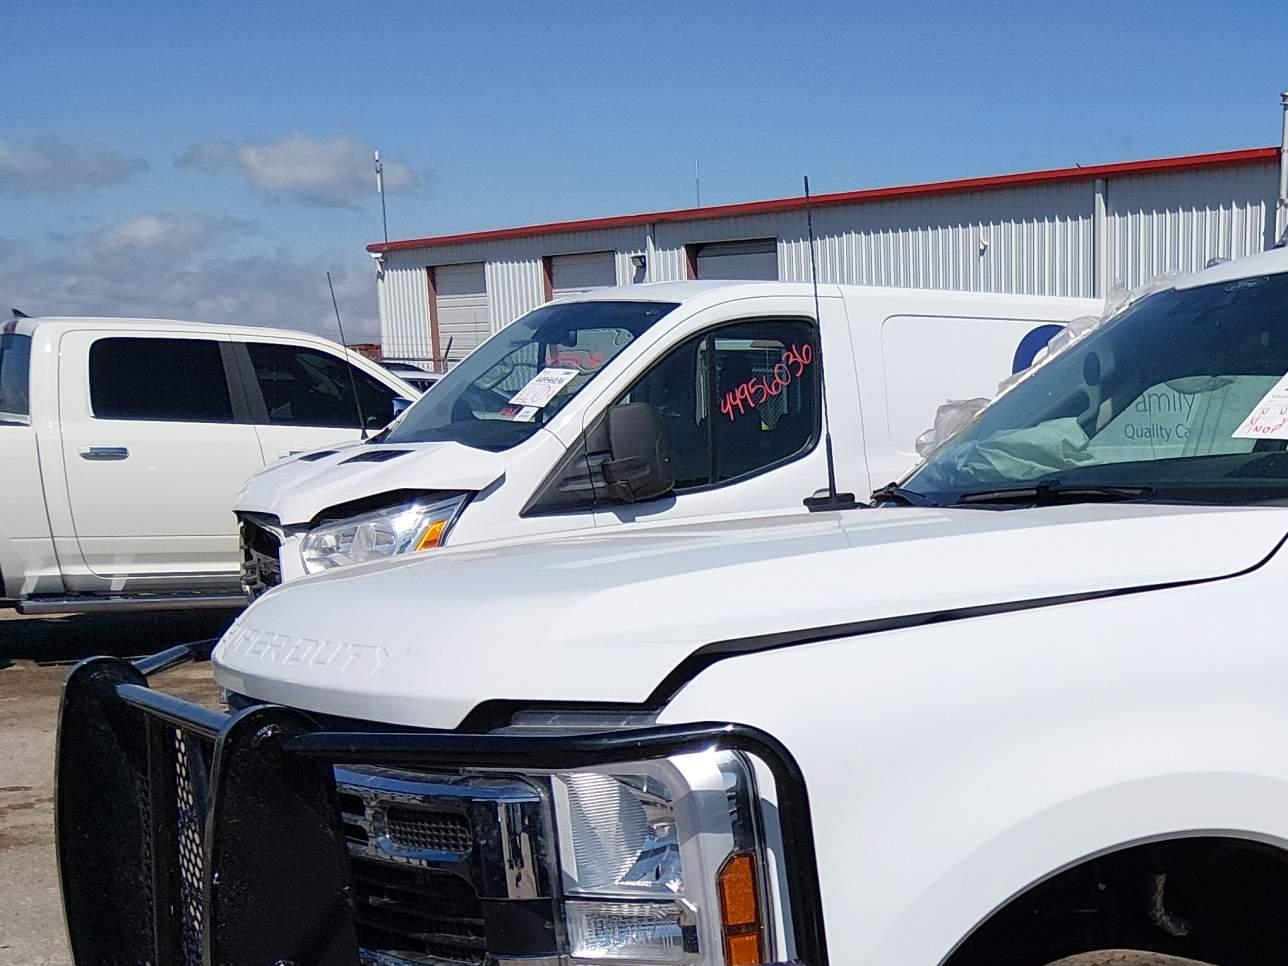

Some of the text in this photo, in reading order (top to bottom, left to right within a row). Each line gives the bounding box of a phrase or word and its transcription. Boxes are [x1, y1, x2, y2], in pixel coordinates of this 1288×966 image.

[720, 343, 812, 421] 44956036
[1134, 392, 1196, 422] amily
[1124, 423, 1172, 442] Quality
